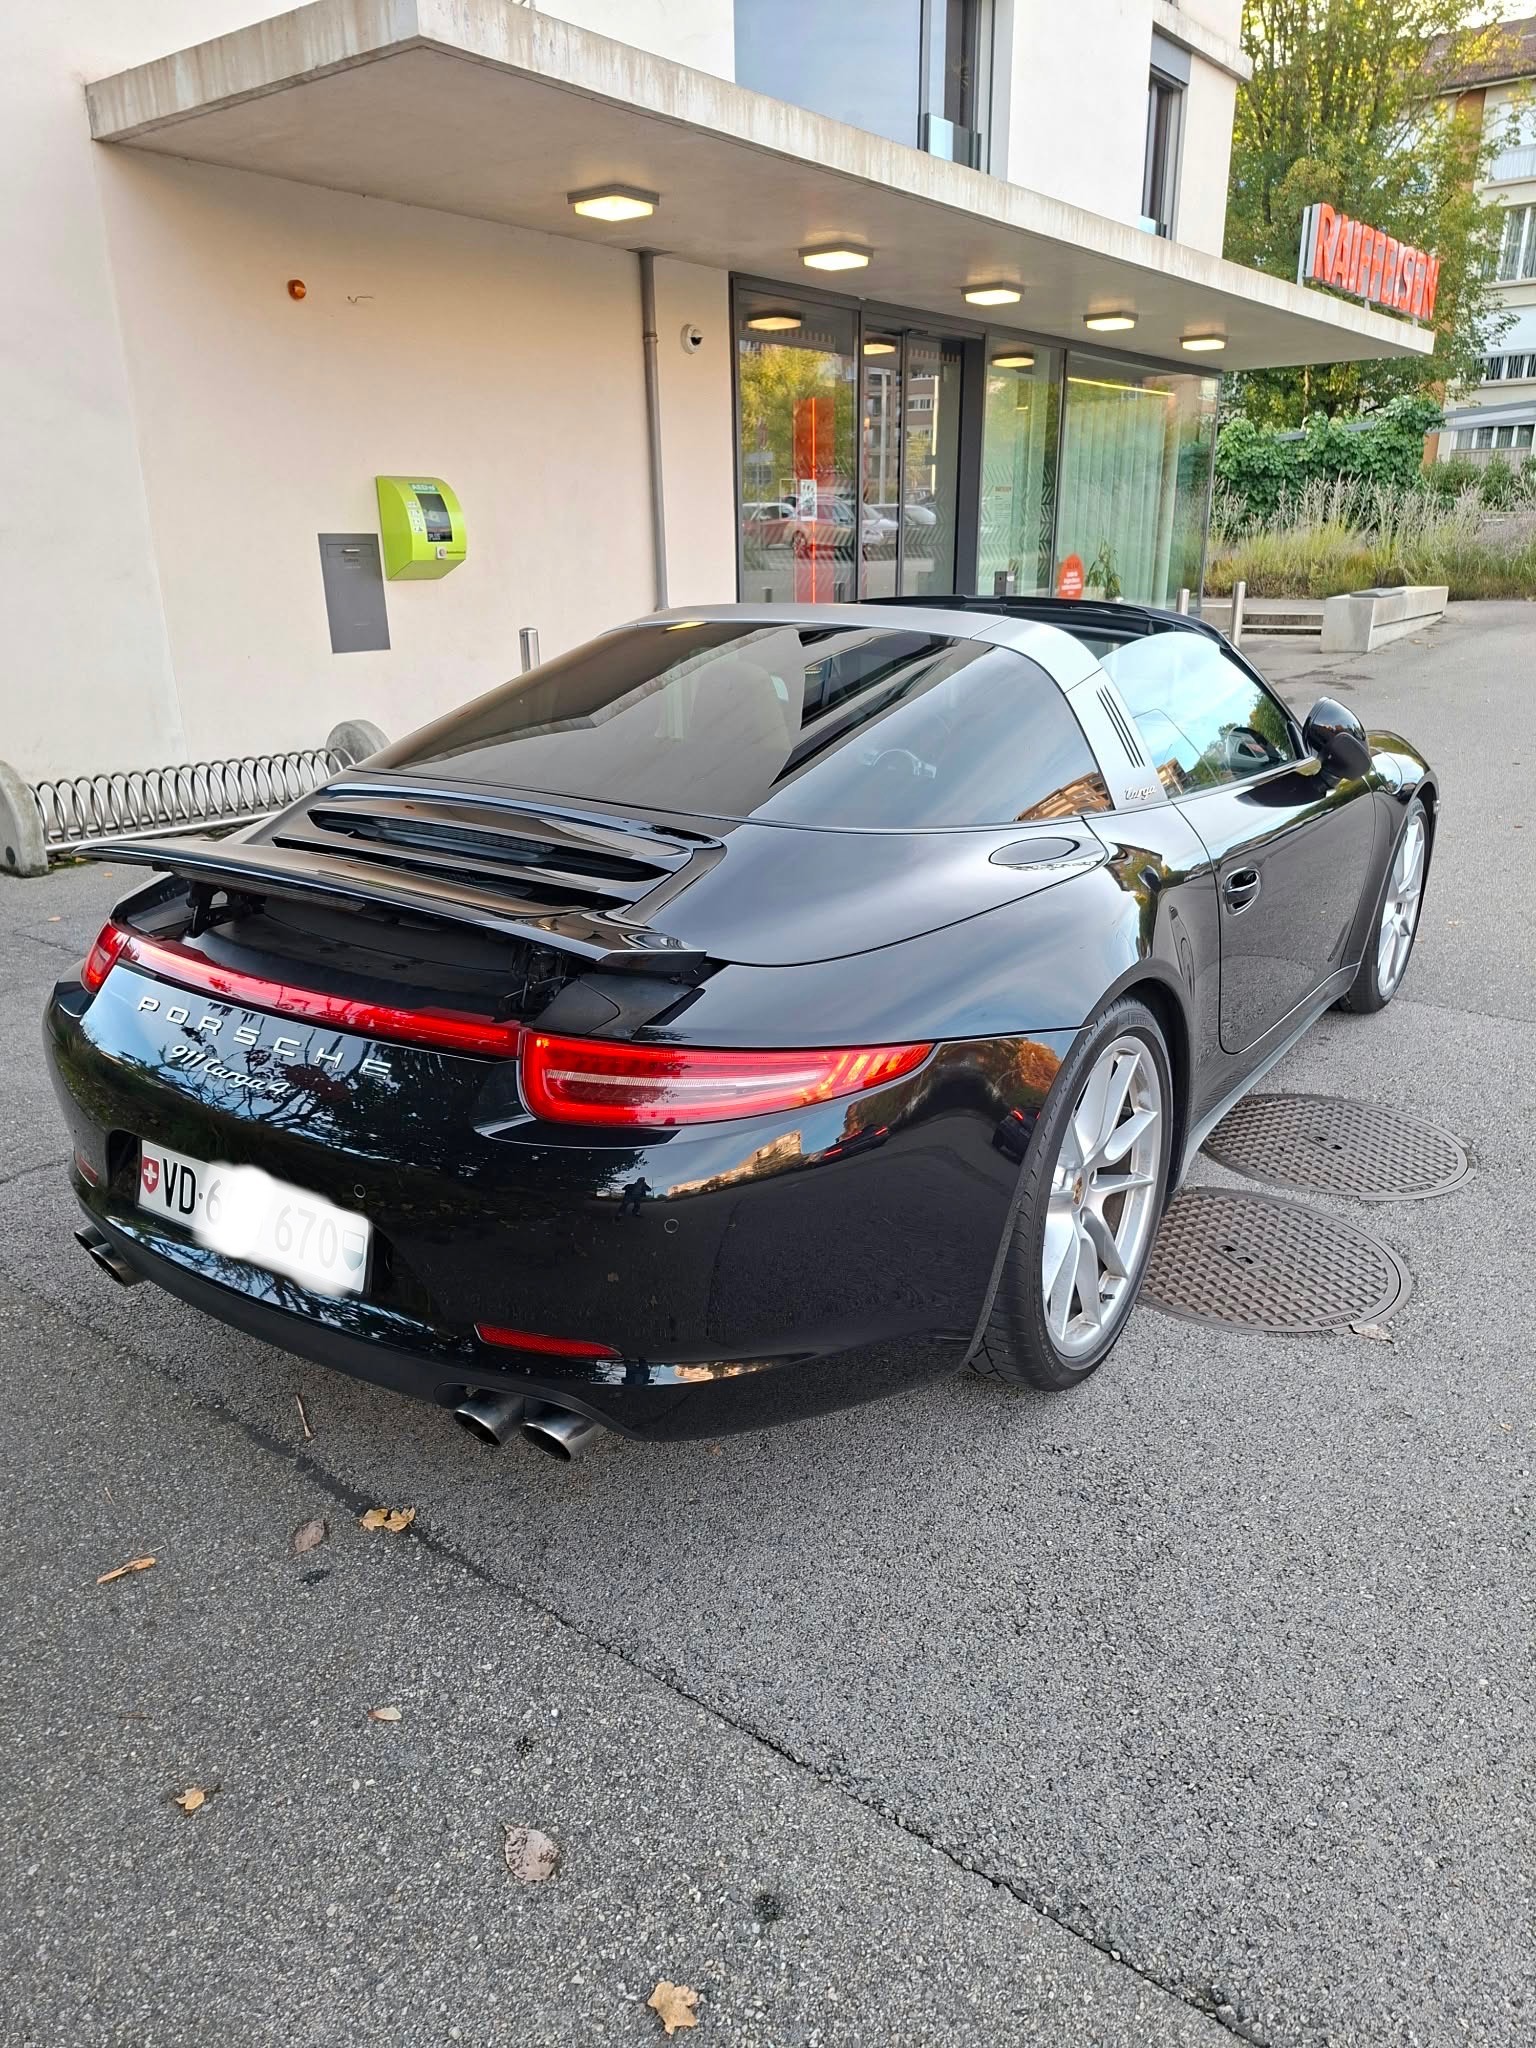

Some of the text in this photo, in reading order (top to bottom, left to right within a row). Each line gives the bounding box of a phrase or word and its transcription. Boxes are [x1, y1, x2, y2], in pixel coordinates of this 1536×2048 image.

[1306, 202, 1440, 321] RAIFFEISEN
[1124, 785, 1156, 801] Targa
[138, 996, 392, 1080] PORSCHE
[171, 1045, 290, 1095] 911 Targa 4
